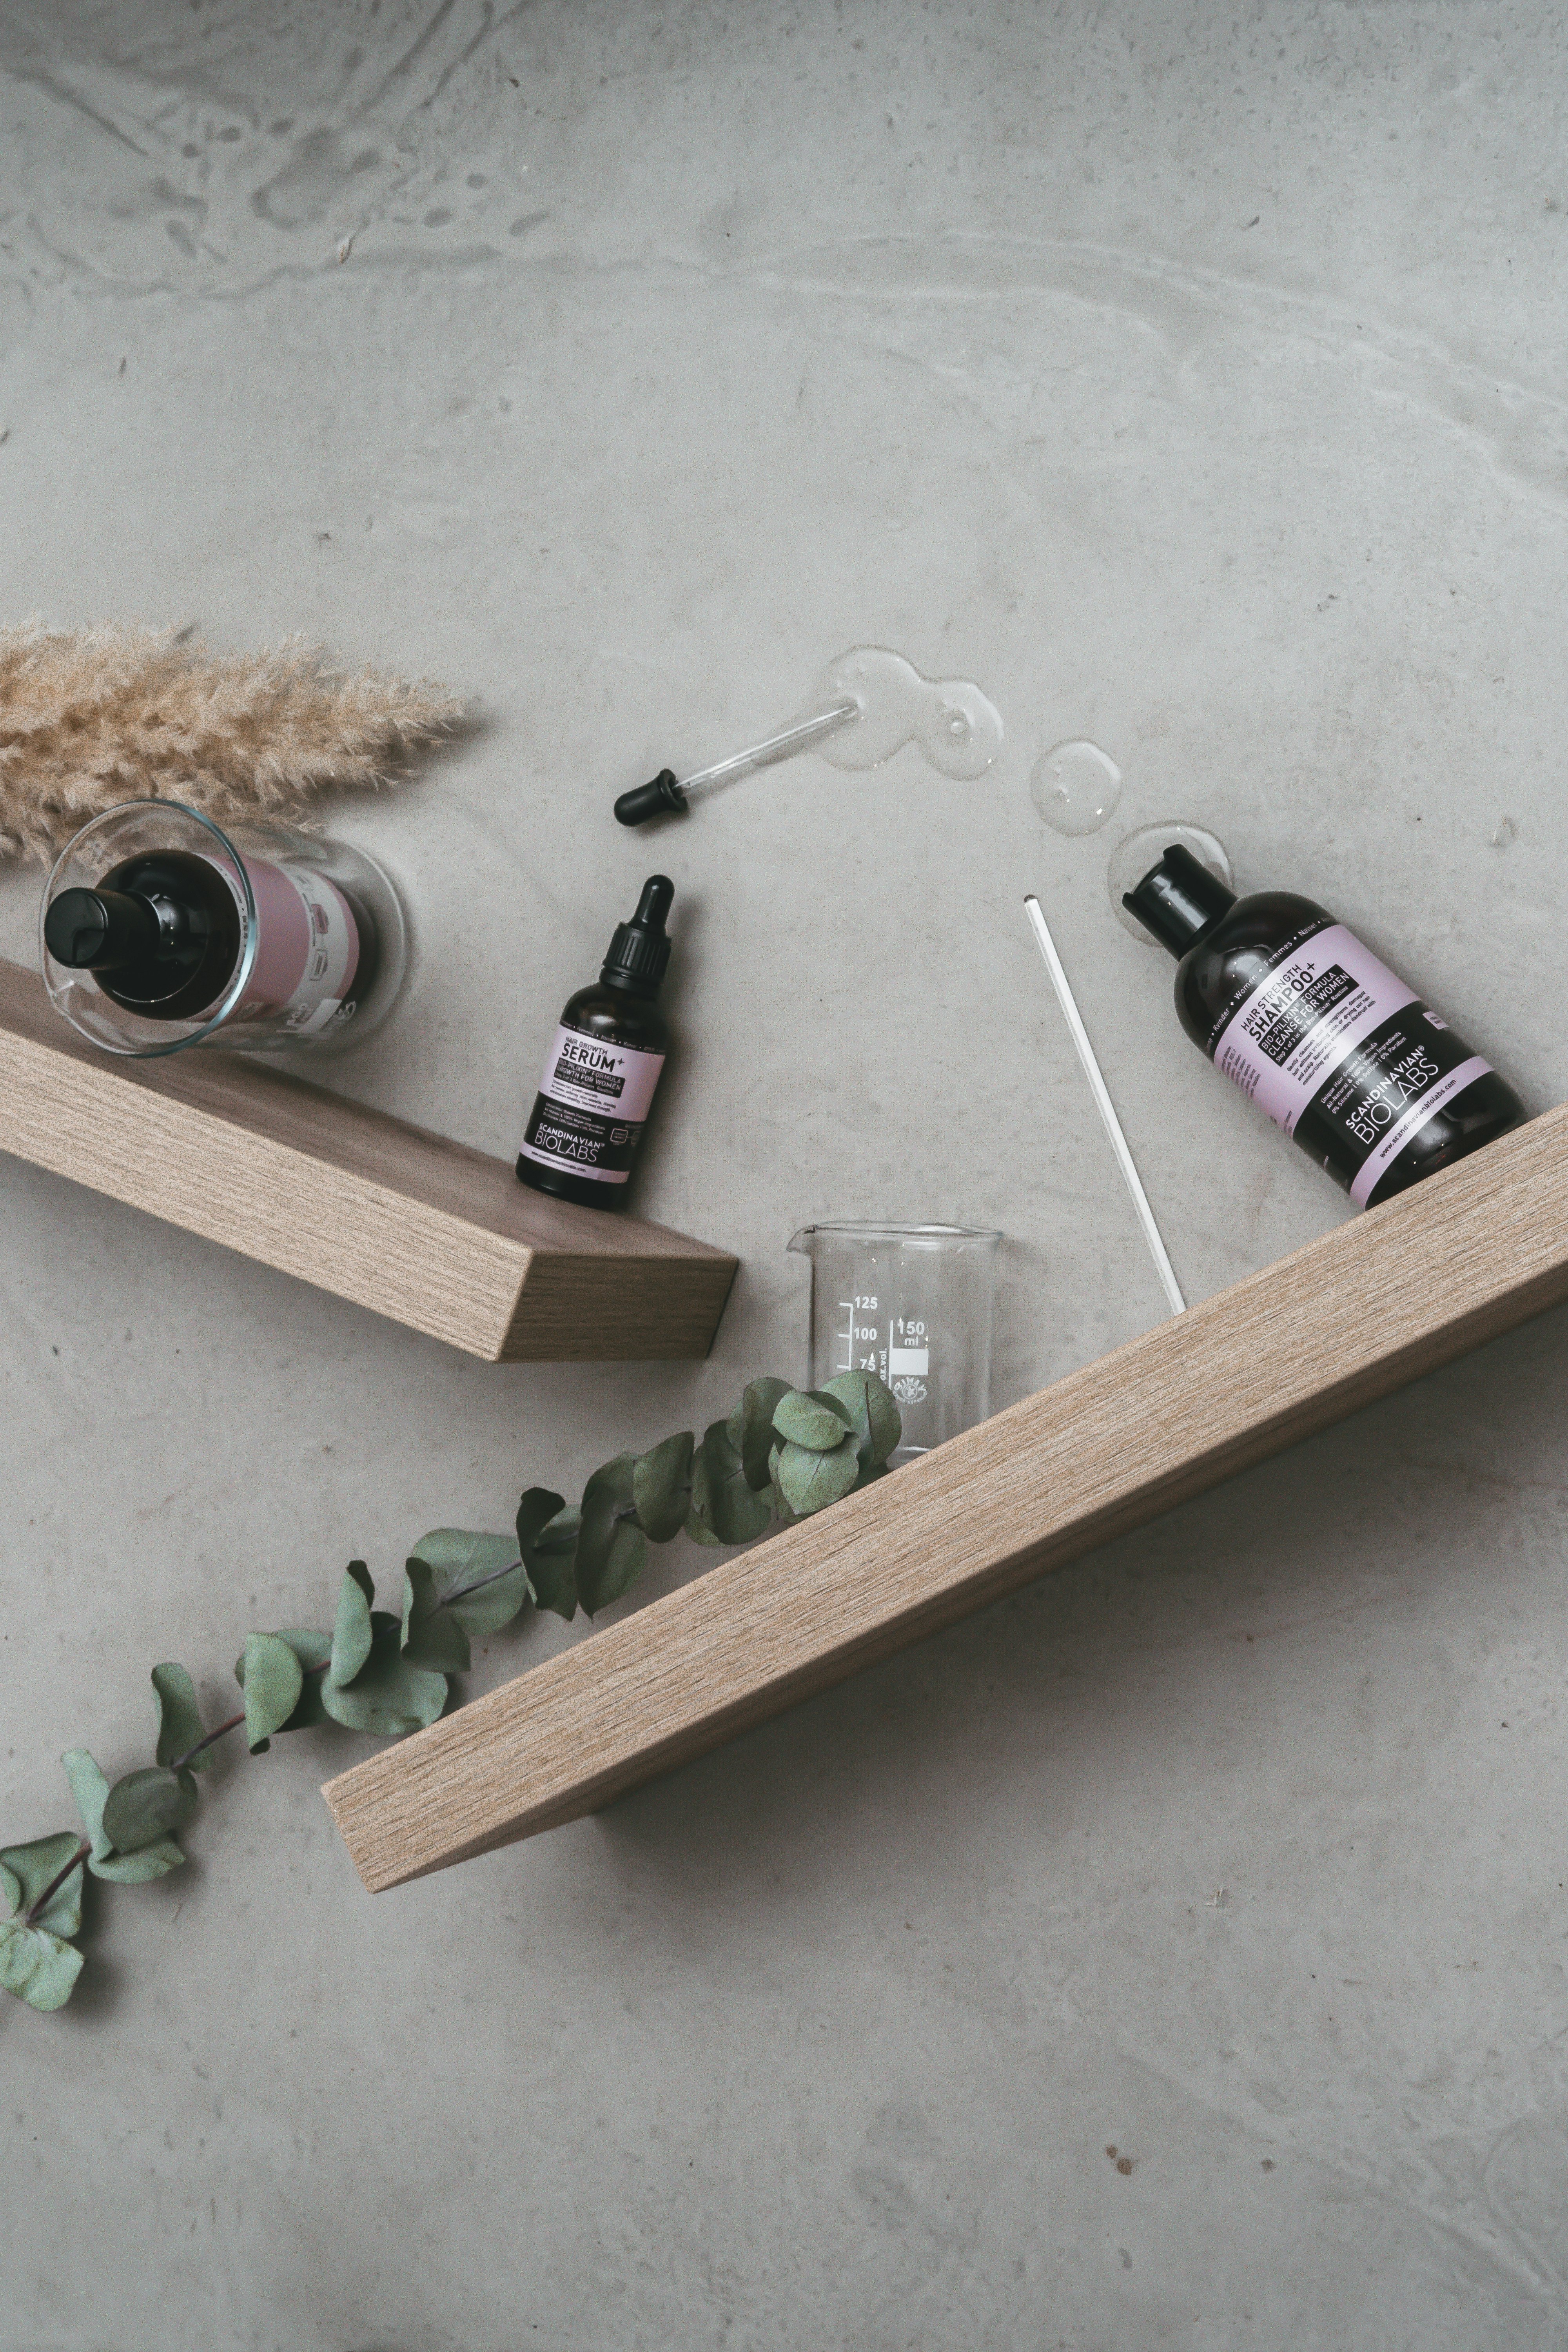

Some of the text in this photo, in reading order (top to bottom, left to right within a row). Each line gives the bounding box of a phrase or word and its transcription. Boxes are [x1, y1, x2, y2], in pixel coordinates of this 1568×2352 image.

[1213, 1008, 1229, 1031] Kvinder
[1234, 975, 1257, 999] Women
[1263, 942, 1292, 967] Femmes
[1241, 964, 1301, 1031] HAIR STRENGTH
[1300, 973, 1336, 1005] FORMULA
[1269, 973, 1349, 1056] CLEANSE FOR WOMEN
[1276, 1051, 1285, 1062] Step
[1331, 986, 1348, 1000] Routine
[558, 1067, 579, 1077] ROWTH
[596, 1080, 620, 1090] WOMEN
[1334, 1077, 1343, 1087] Hair
[1354, 1058, 1438, 1144] BIOLABS
[535, 1131, 598, 1162] BIOLABS
[855, 1296, 877, 1309] 125
[855, 1328, 877, 1340] 100
[898, 1320, 924, 1334] 150
[905, 1336, 918, 1345] ml
[860, 1359, 875, 1371] 75
